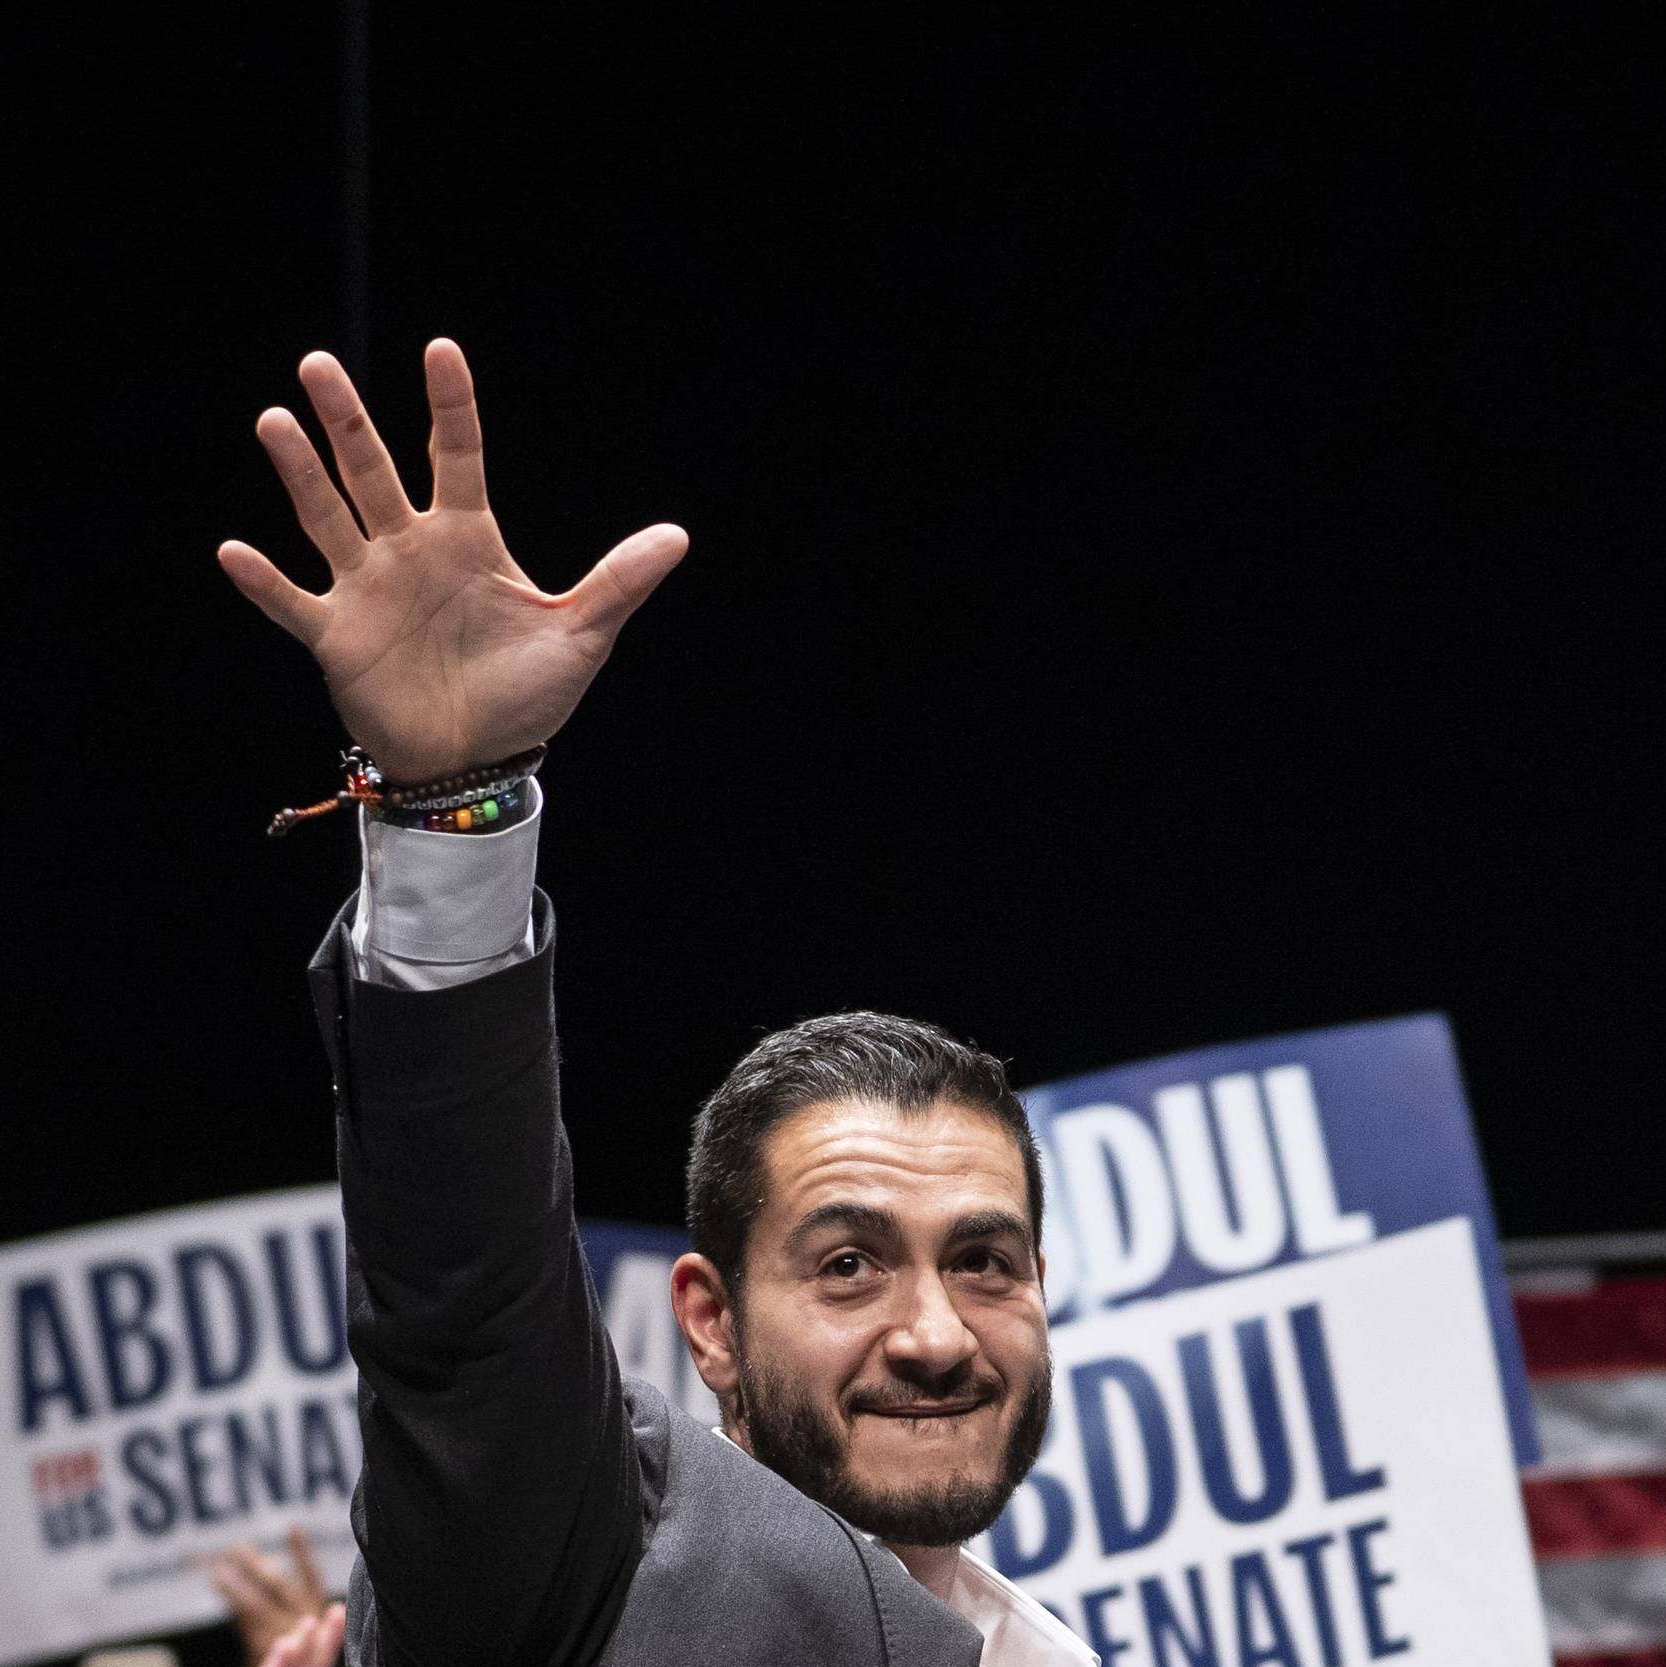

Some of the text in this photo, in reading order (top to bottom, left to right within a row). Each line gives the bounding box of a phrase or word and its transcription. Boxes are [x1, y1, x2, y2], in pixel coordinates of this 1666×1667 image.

[1039, 1062, 1378, 1322] DUL
[10, 1219, 360, 1438] ABDU
[120, 1395, 359, 1537] SENA
